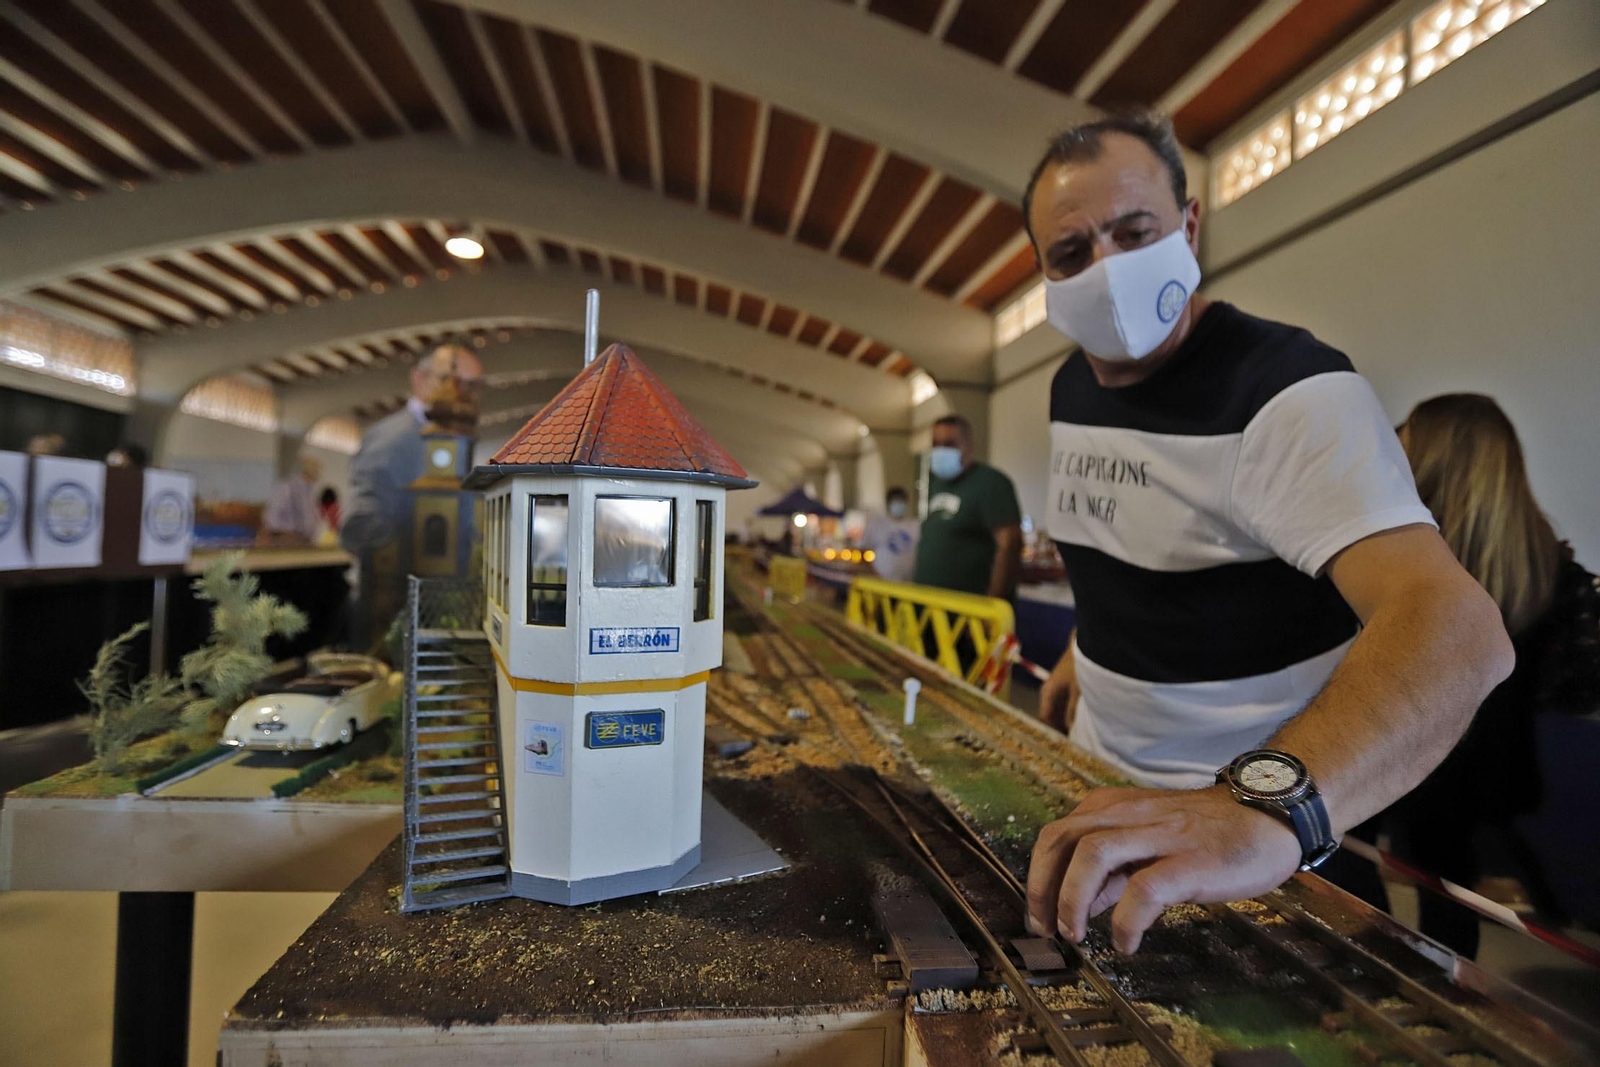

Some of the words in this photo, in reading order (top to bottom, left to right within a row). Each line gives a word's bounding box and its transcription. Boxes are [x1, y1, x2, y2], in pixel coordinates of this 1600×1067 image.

[1066, 451, 1151, 488] CAPITAINE
[1058, 490, 1076, 515] LA
[1086, 494, 1117, 524] MER
[598, 634, 612, 648] EL
[623, 722, 657, 739] FEVE
